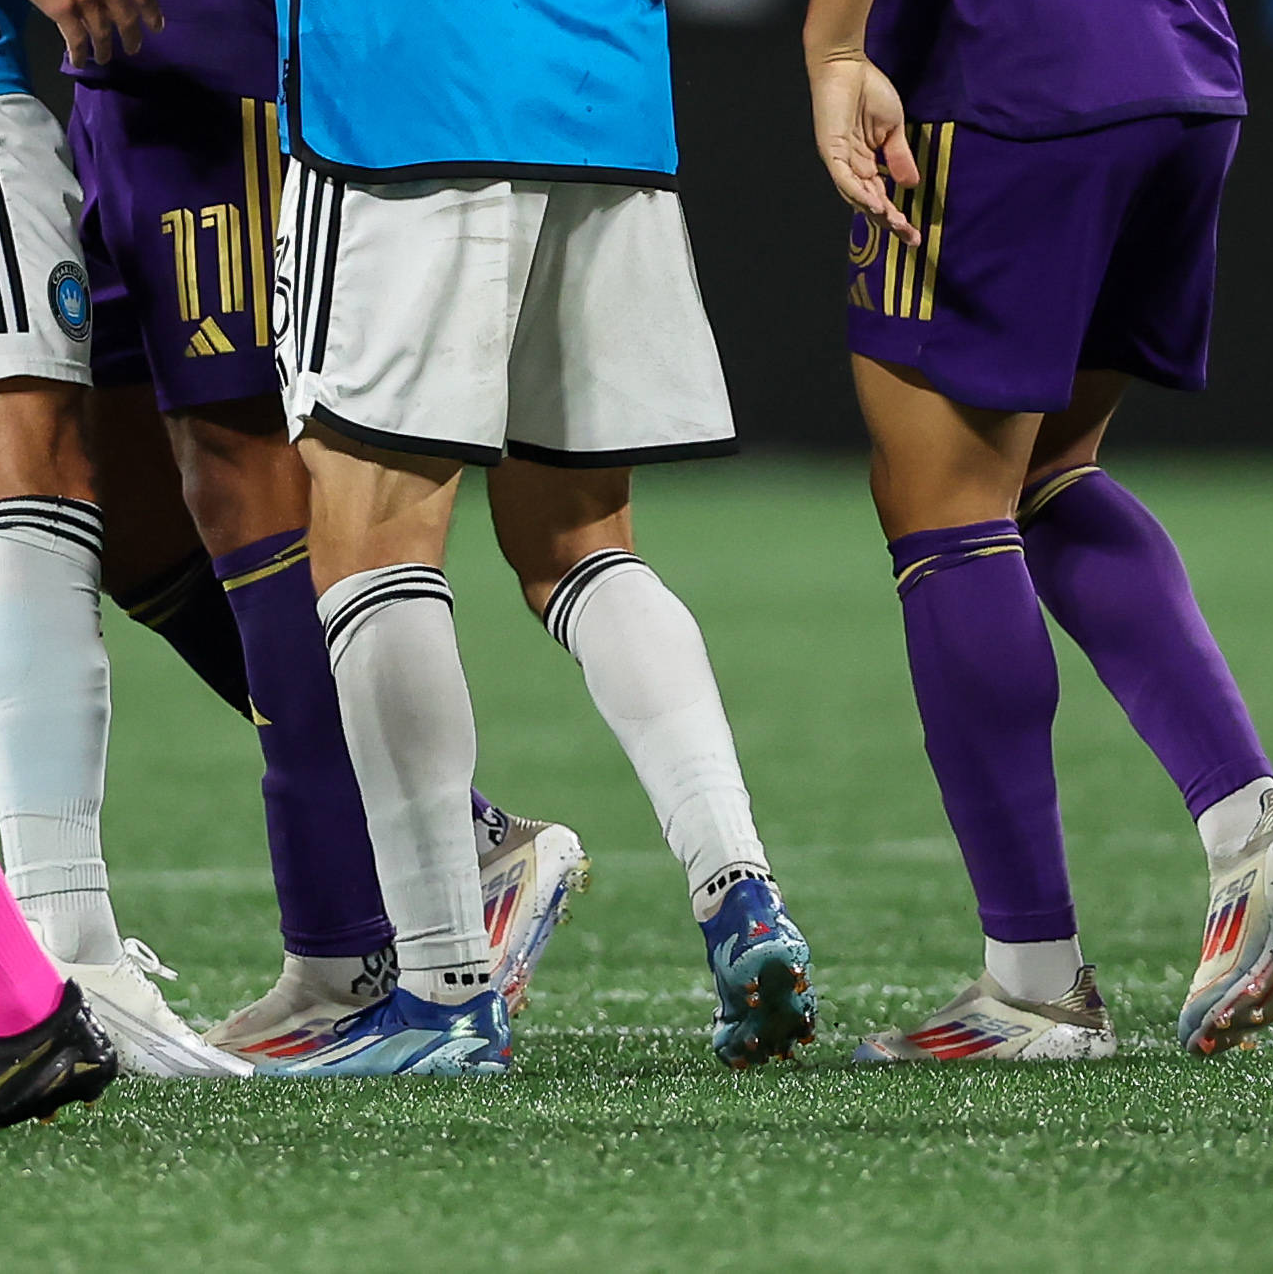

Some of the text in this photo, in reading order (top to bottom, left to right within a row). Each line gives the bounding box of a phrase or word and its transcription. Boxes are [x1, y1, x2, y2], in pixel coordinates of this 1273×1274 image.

[160, 203, 245, 323] 11
[483, 858, 526, 900] 50
[1212, 868, 1258, 913] F50
